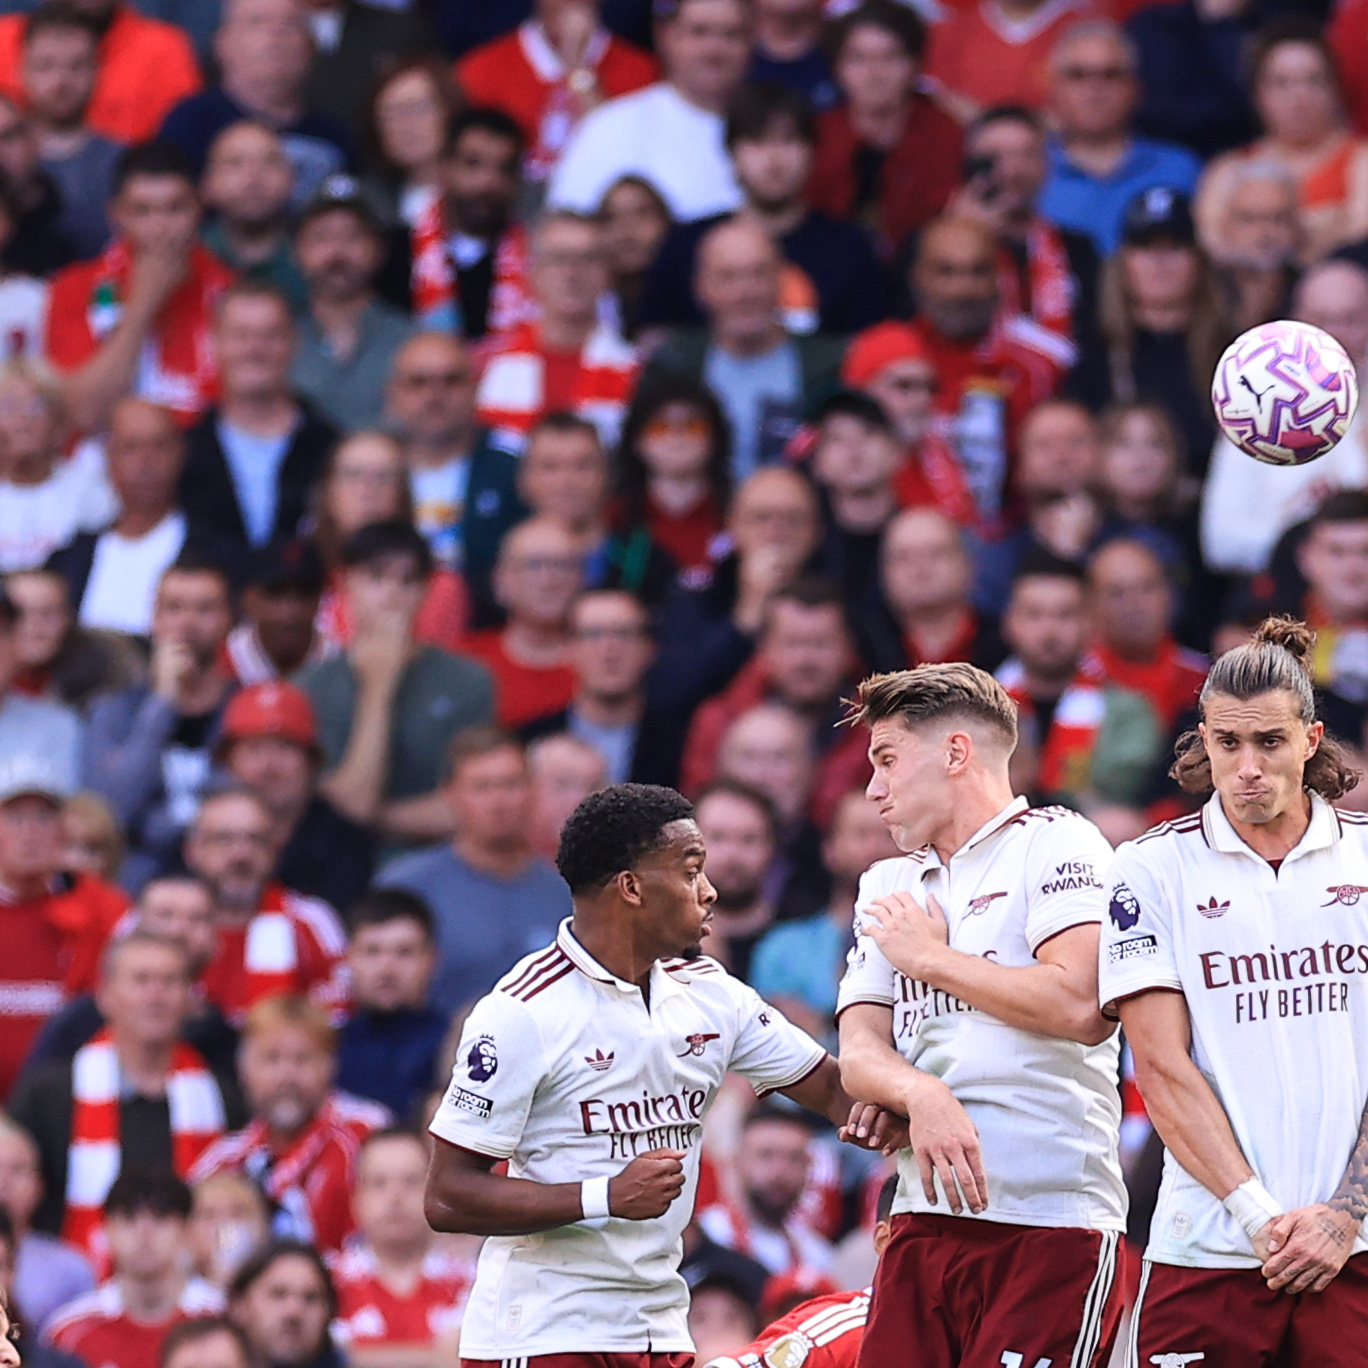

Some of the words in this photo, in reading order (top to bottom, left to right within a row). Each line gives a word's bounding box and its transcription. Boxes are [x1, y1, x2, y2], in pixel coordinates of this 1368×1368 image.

[1056, 862, 1094, 876] VISIT
[1041, 876, 1104, 895] RWAND
[1236, 989, 1269, 1024] FLY
[1278, 982, 1348, 1018] BETTER
